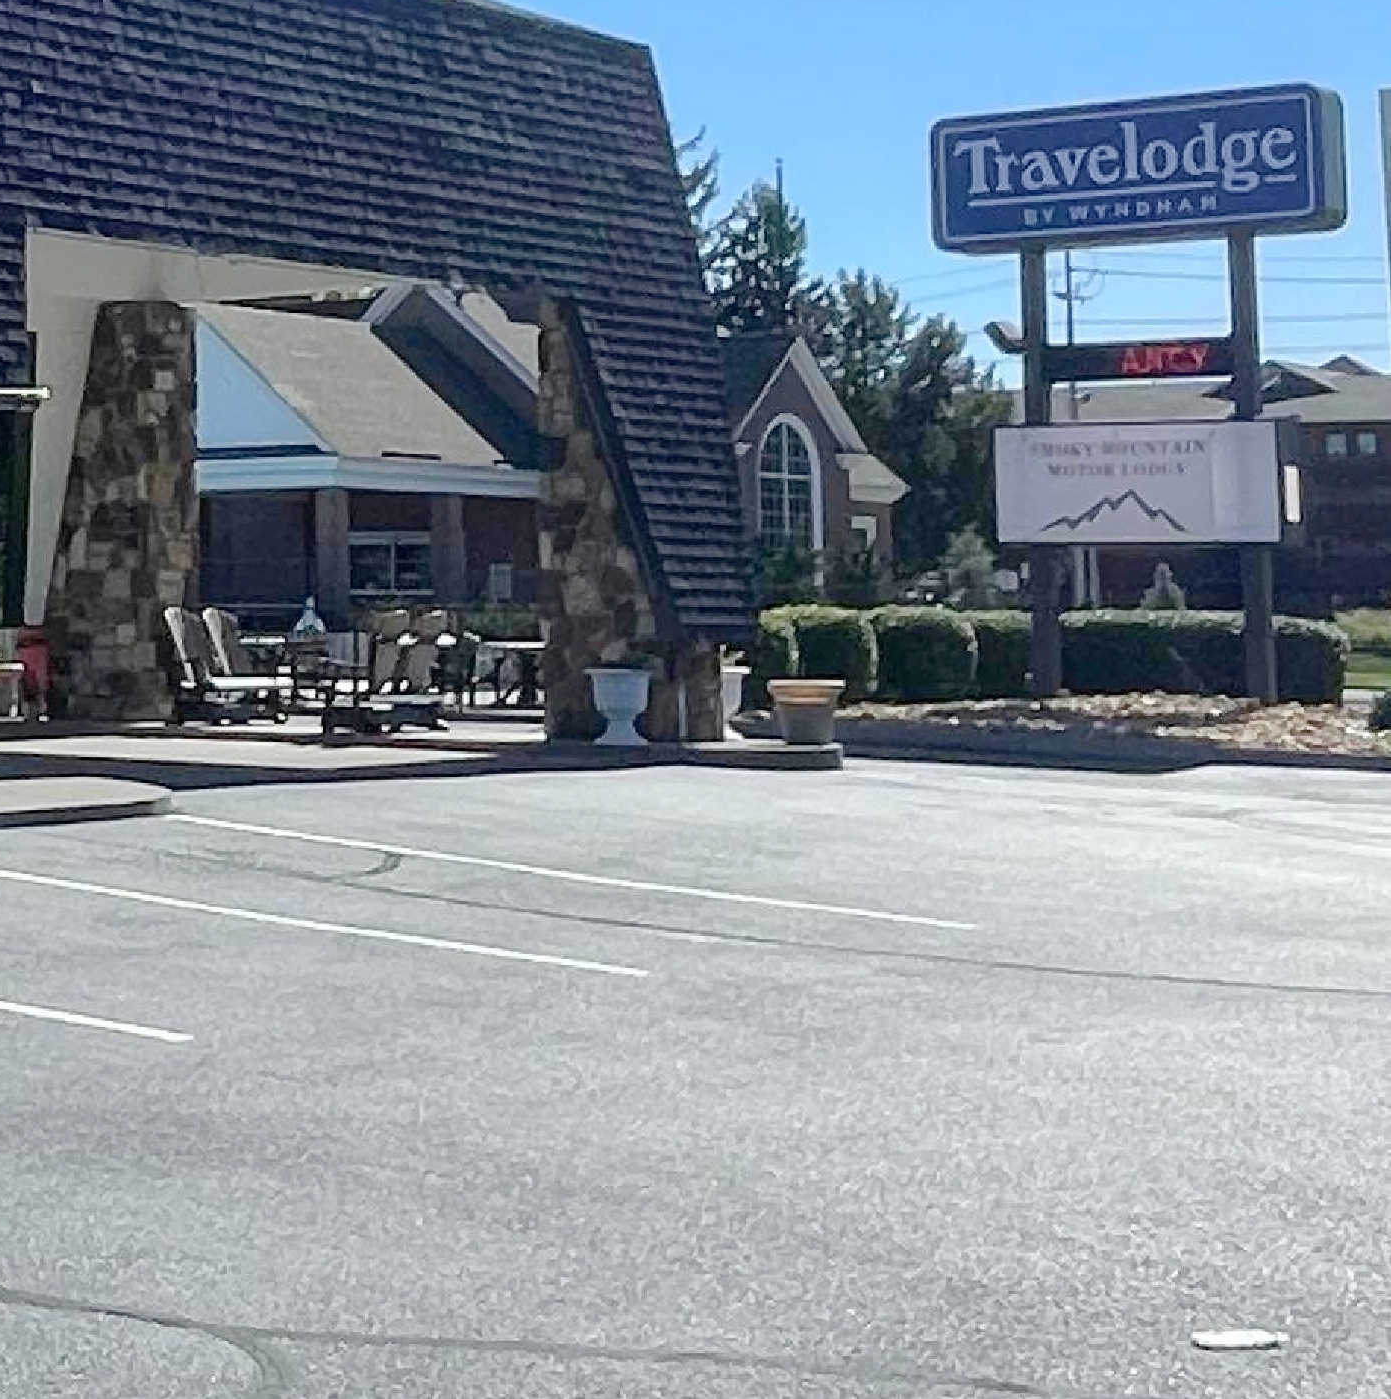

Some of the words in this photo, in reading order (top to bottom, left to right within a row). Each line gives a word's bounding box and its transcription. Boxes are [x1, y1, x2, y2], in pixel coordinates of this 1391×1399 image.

[953, 121, 1297, 194] Travelodge
[1023, 207, 1056, 226] BY
[1069, 196, 1217, 222] WYNDHAM
